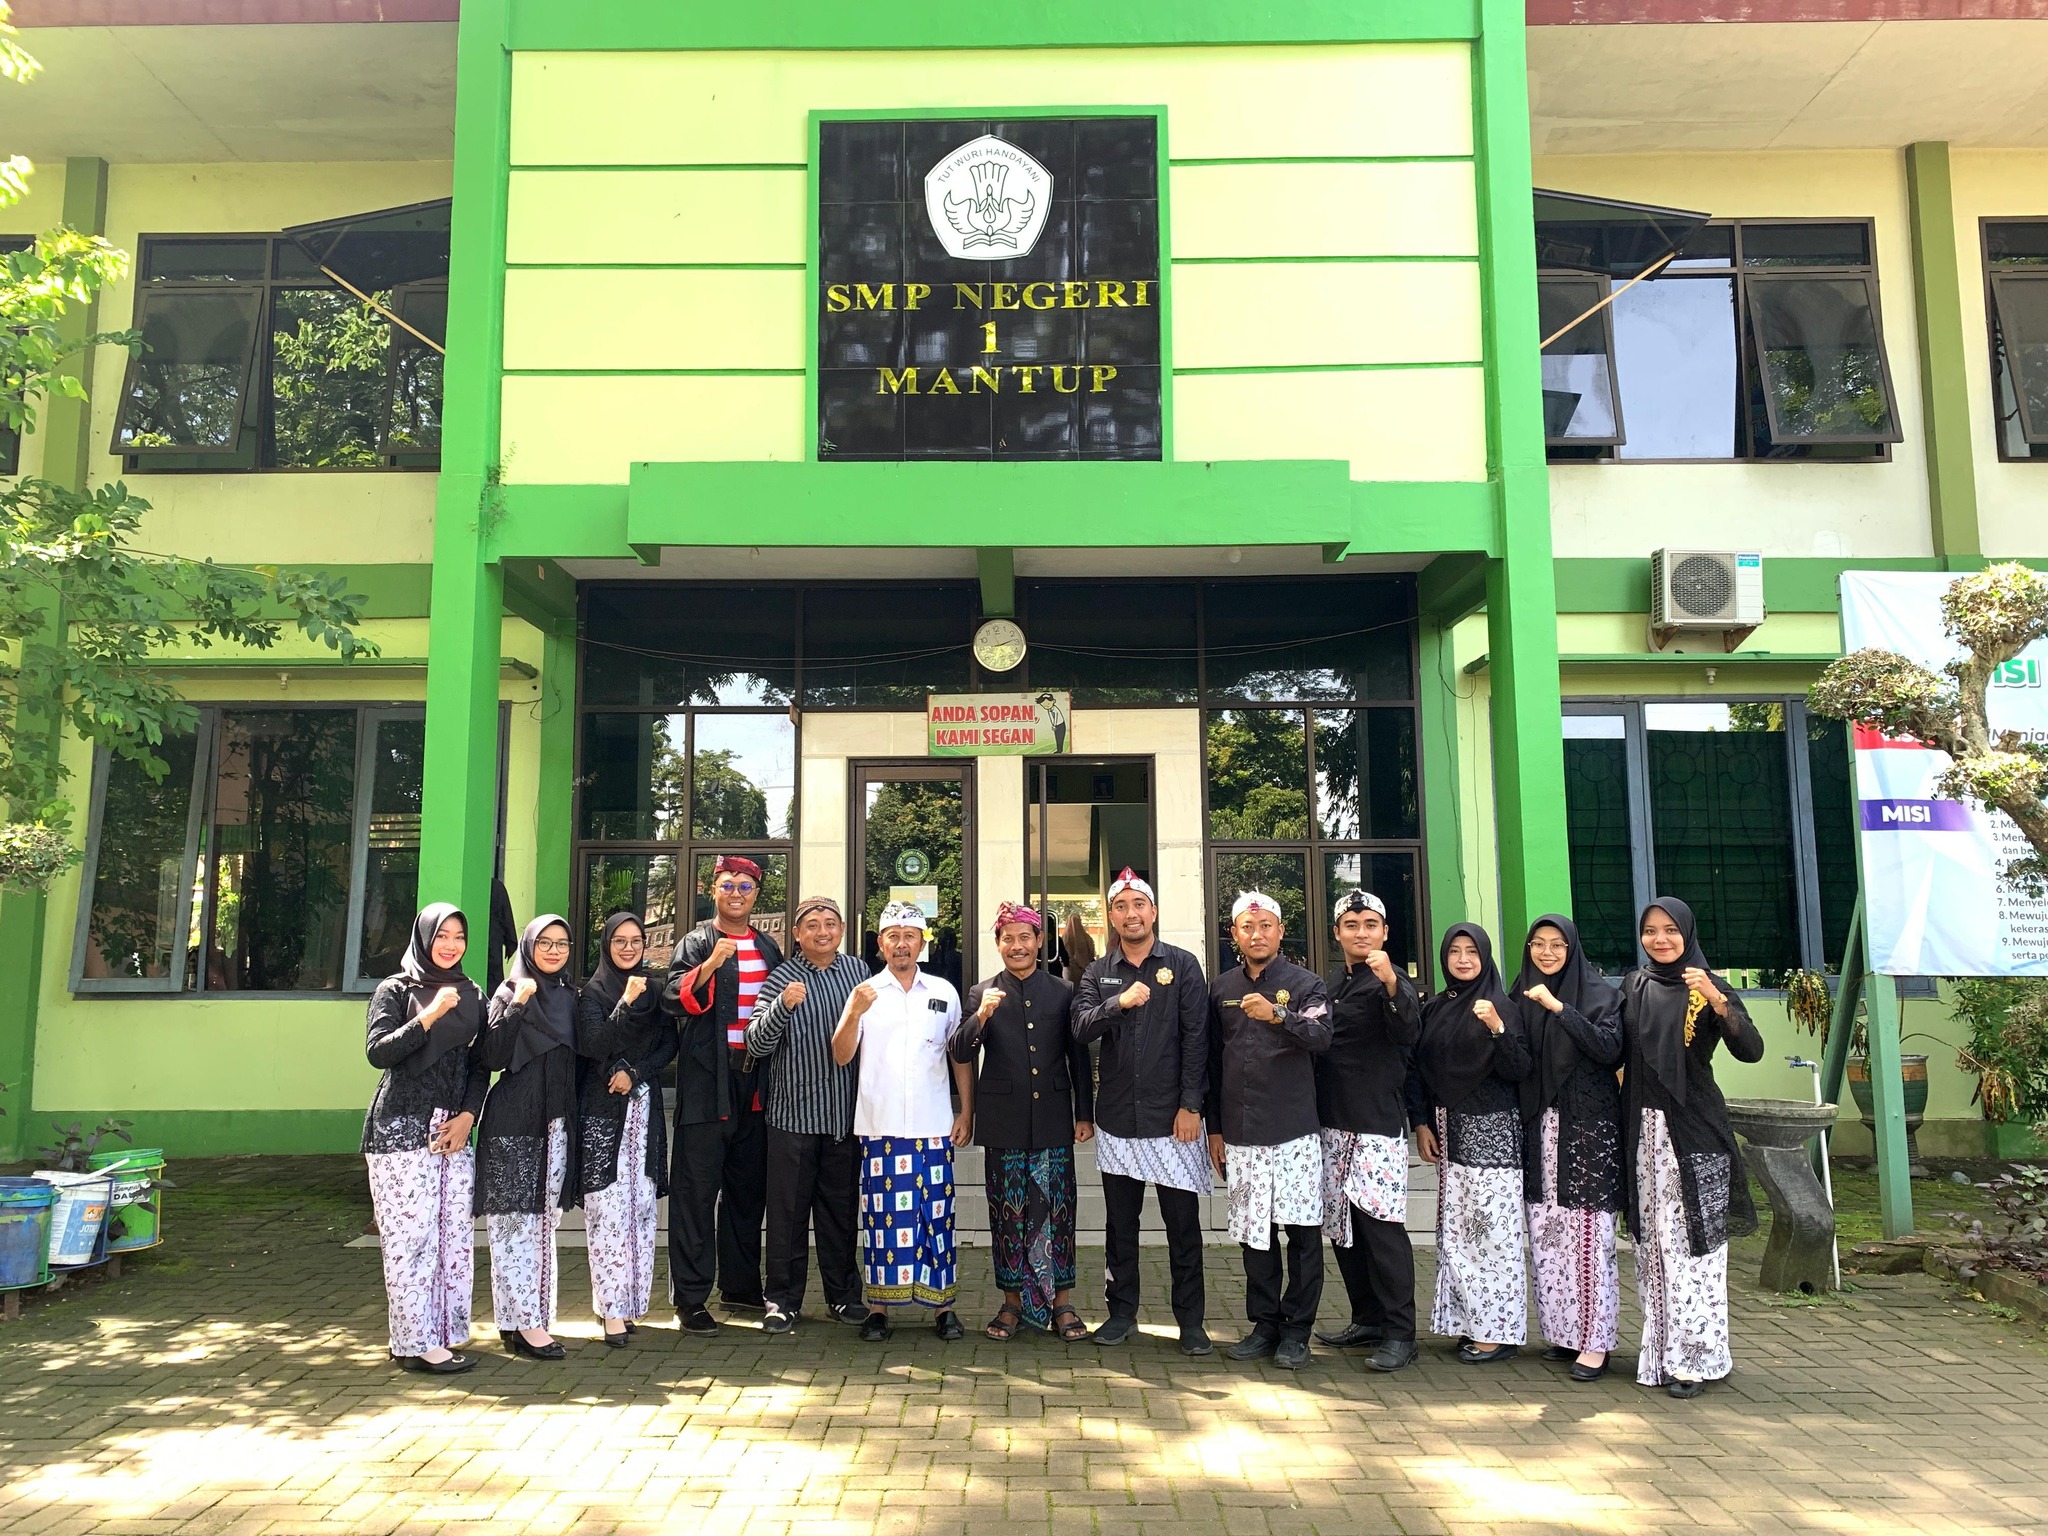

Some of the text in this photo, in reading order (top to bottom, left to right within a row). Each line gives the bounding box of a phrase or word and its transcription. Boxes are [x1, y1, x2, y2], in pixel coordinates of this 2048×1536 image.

[938, 148, 1041, 183] TUT WURI HANDAYANI
[827, 280, 1151, 312] SMP NEGERI
[979, 320, 1001, 353] 1
[876, 365, 1118, 395] MANTUP
[931, 705, 1040, 724] ANDA SOPAN,
[936, 728, 1035, 745] KAMI SEGAN
[1881, 805, 1931, 822] MISI
[1990, 820, 2020, 829] 2. Me
[1993, 832, 2001, 842] 3.
[2002, 846, 2019, 855] dan
[1994, 858, 2005, 867] 4.
[1995, 884, 2006, 894] 6.
[1997, 897, 2048, 908] 7. Menyel
[1998, 911, 2008, 920] 8.
[2002, 937, 2011, 947] 9.
[2011, 951, 2037, 960] serta
